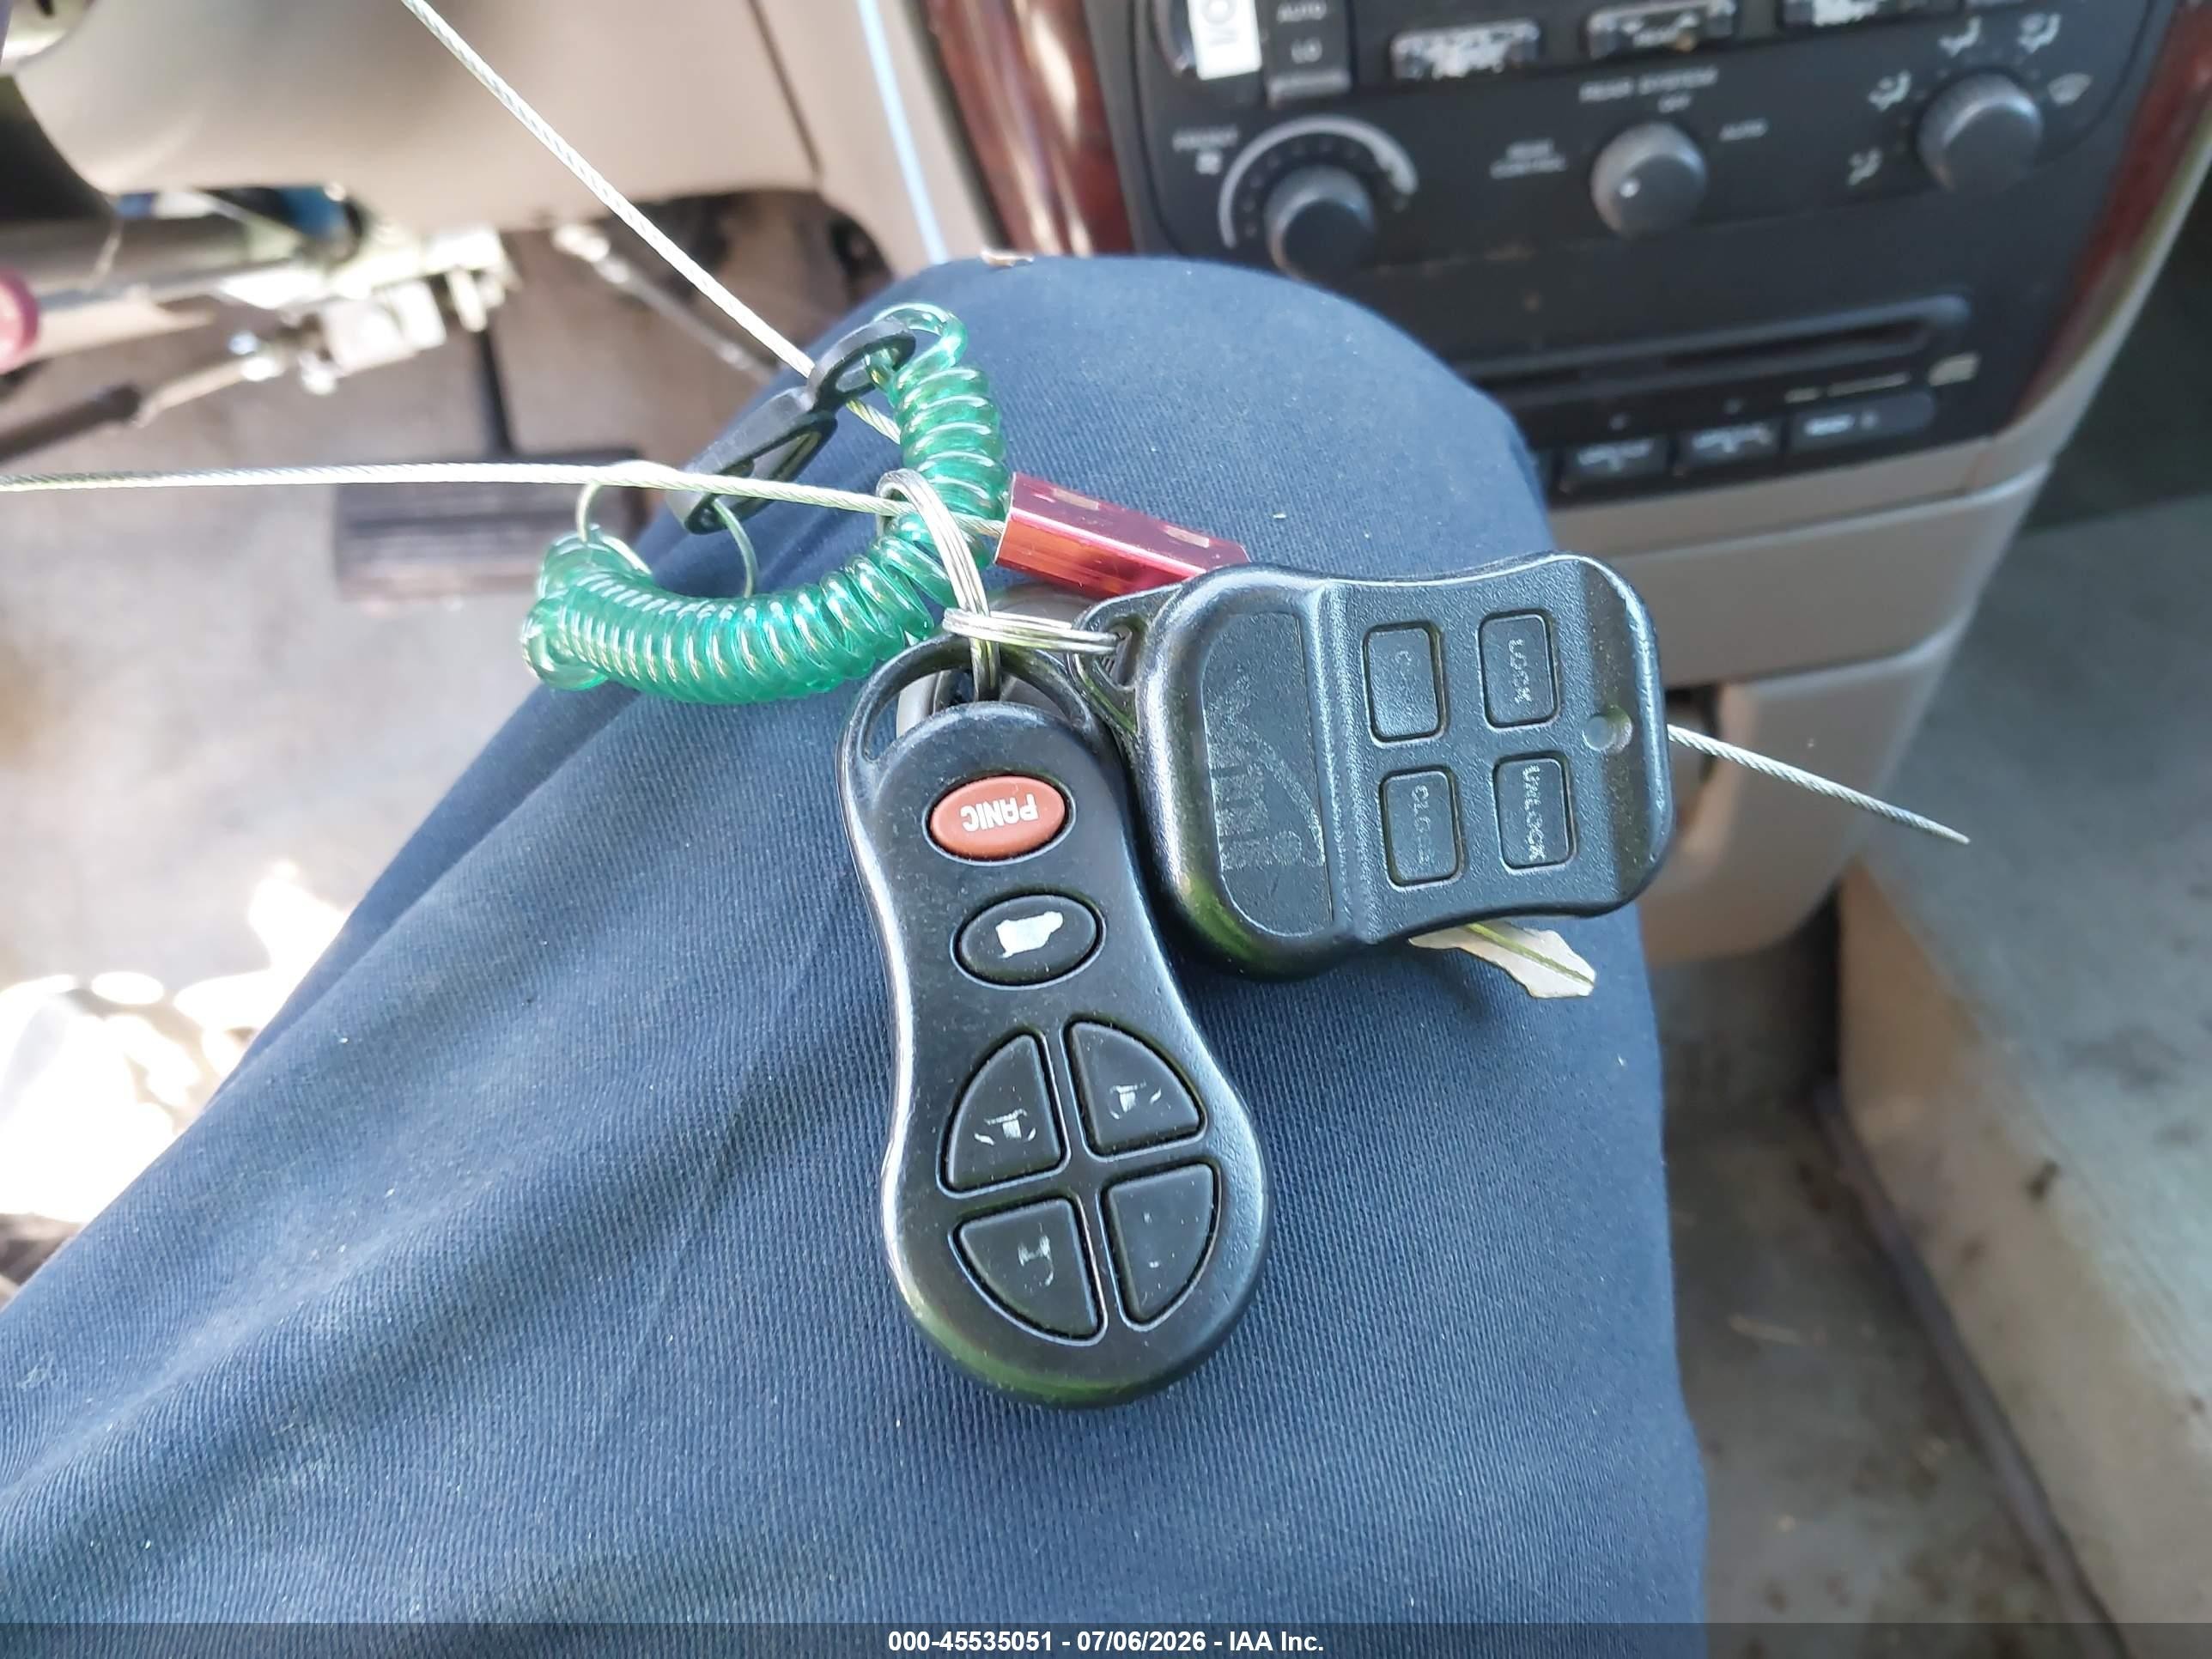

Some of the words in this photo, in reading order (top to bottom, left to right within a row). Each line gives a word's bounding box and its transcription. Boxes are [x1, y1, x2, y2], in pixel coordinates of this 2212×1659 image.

[1508, 638, 1533, 704] LOCK
[959, 793, 1039, 832] PANIC
[1411, 784, 1433, 864] CLO
[1522, 764, 1547, 861] UNLOCK
